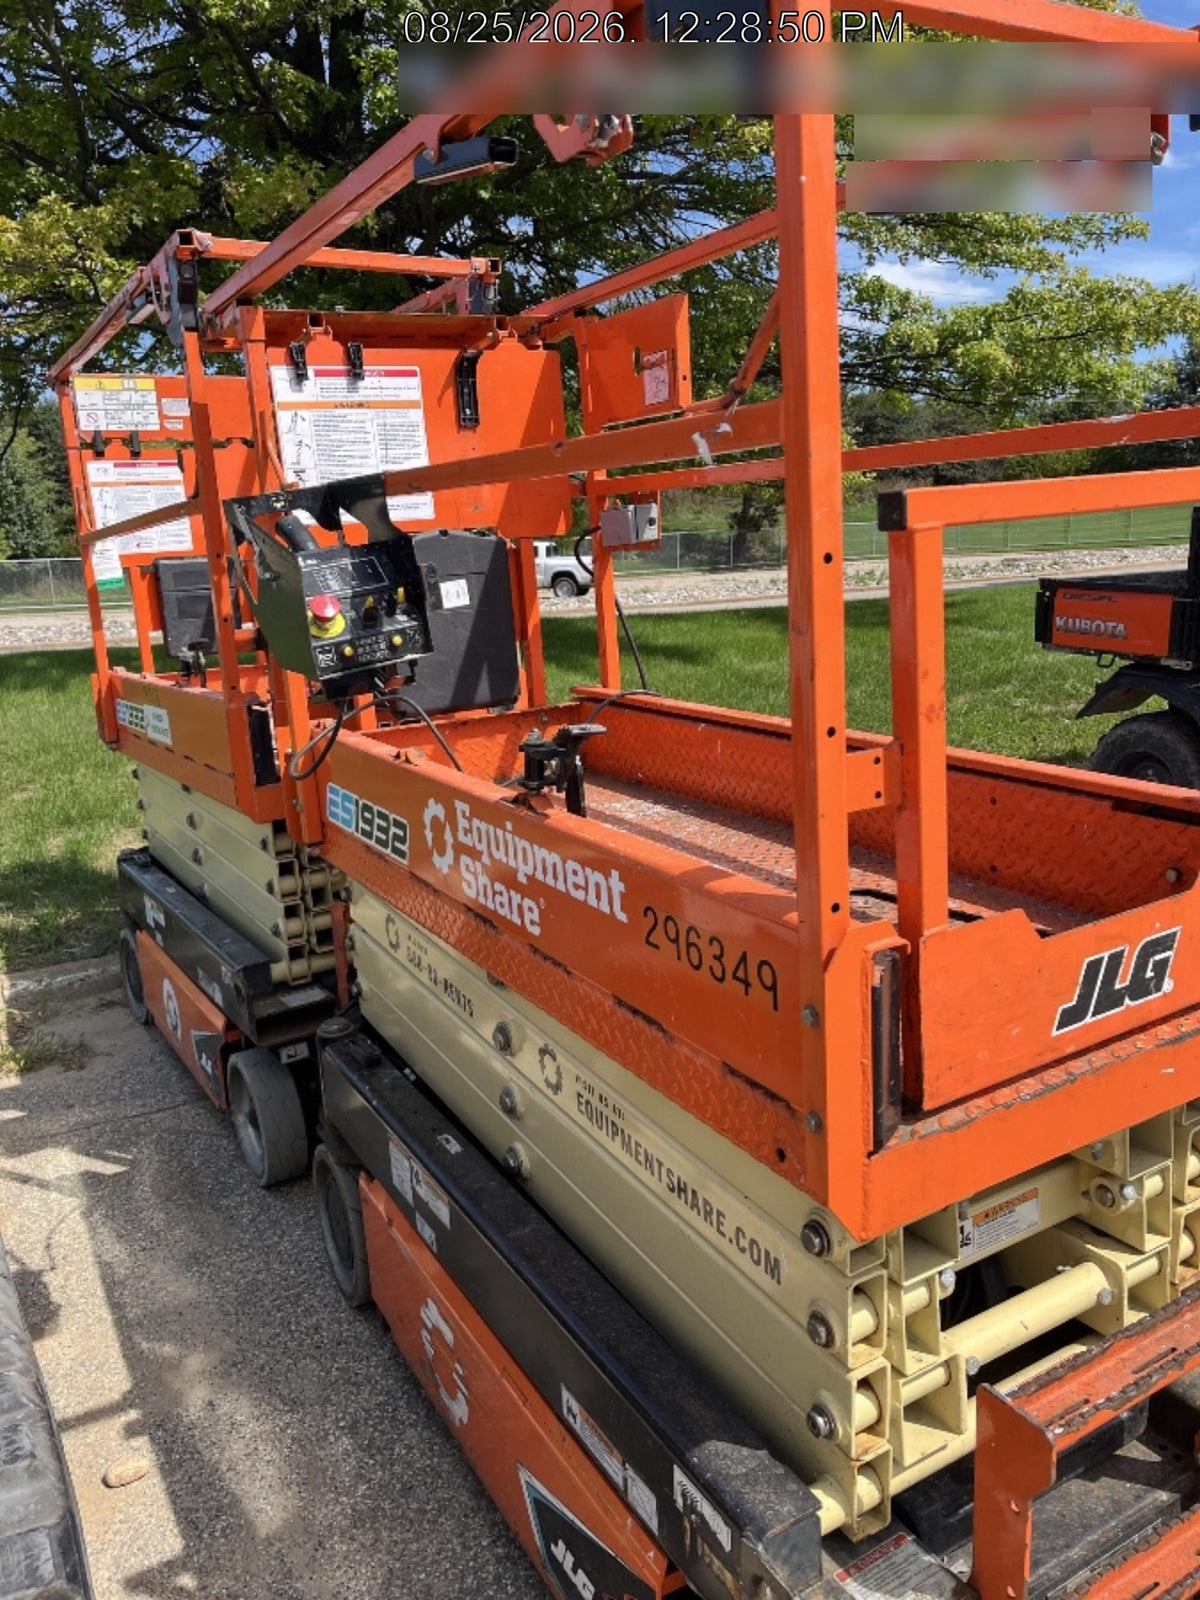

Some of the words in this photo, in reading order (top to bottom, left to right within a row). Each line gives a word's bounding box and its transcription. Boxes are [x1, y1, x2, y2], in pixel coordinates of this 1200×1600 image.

[1055, 616, 1128, 640] KUBOTA
[327, 783, 409, 865] ES1932
[454, 799, 628, 924] Equipment
[460, 853, 541, 937] Share
[643, 905, 779, 1012] 296349
[1051, 925, 1183, 1037] JLG
[576, 1091, 782, 1286] EQUIPMENTSHARE.COM
